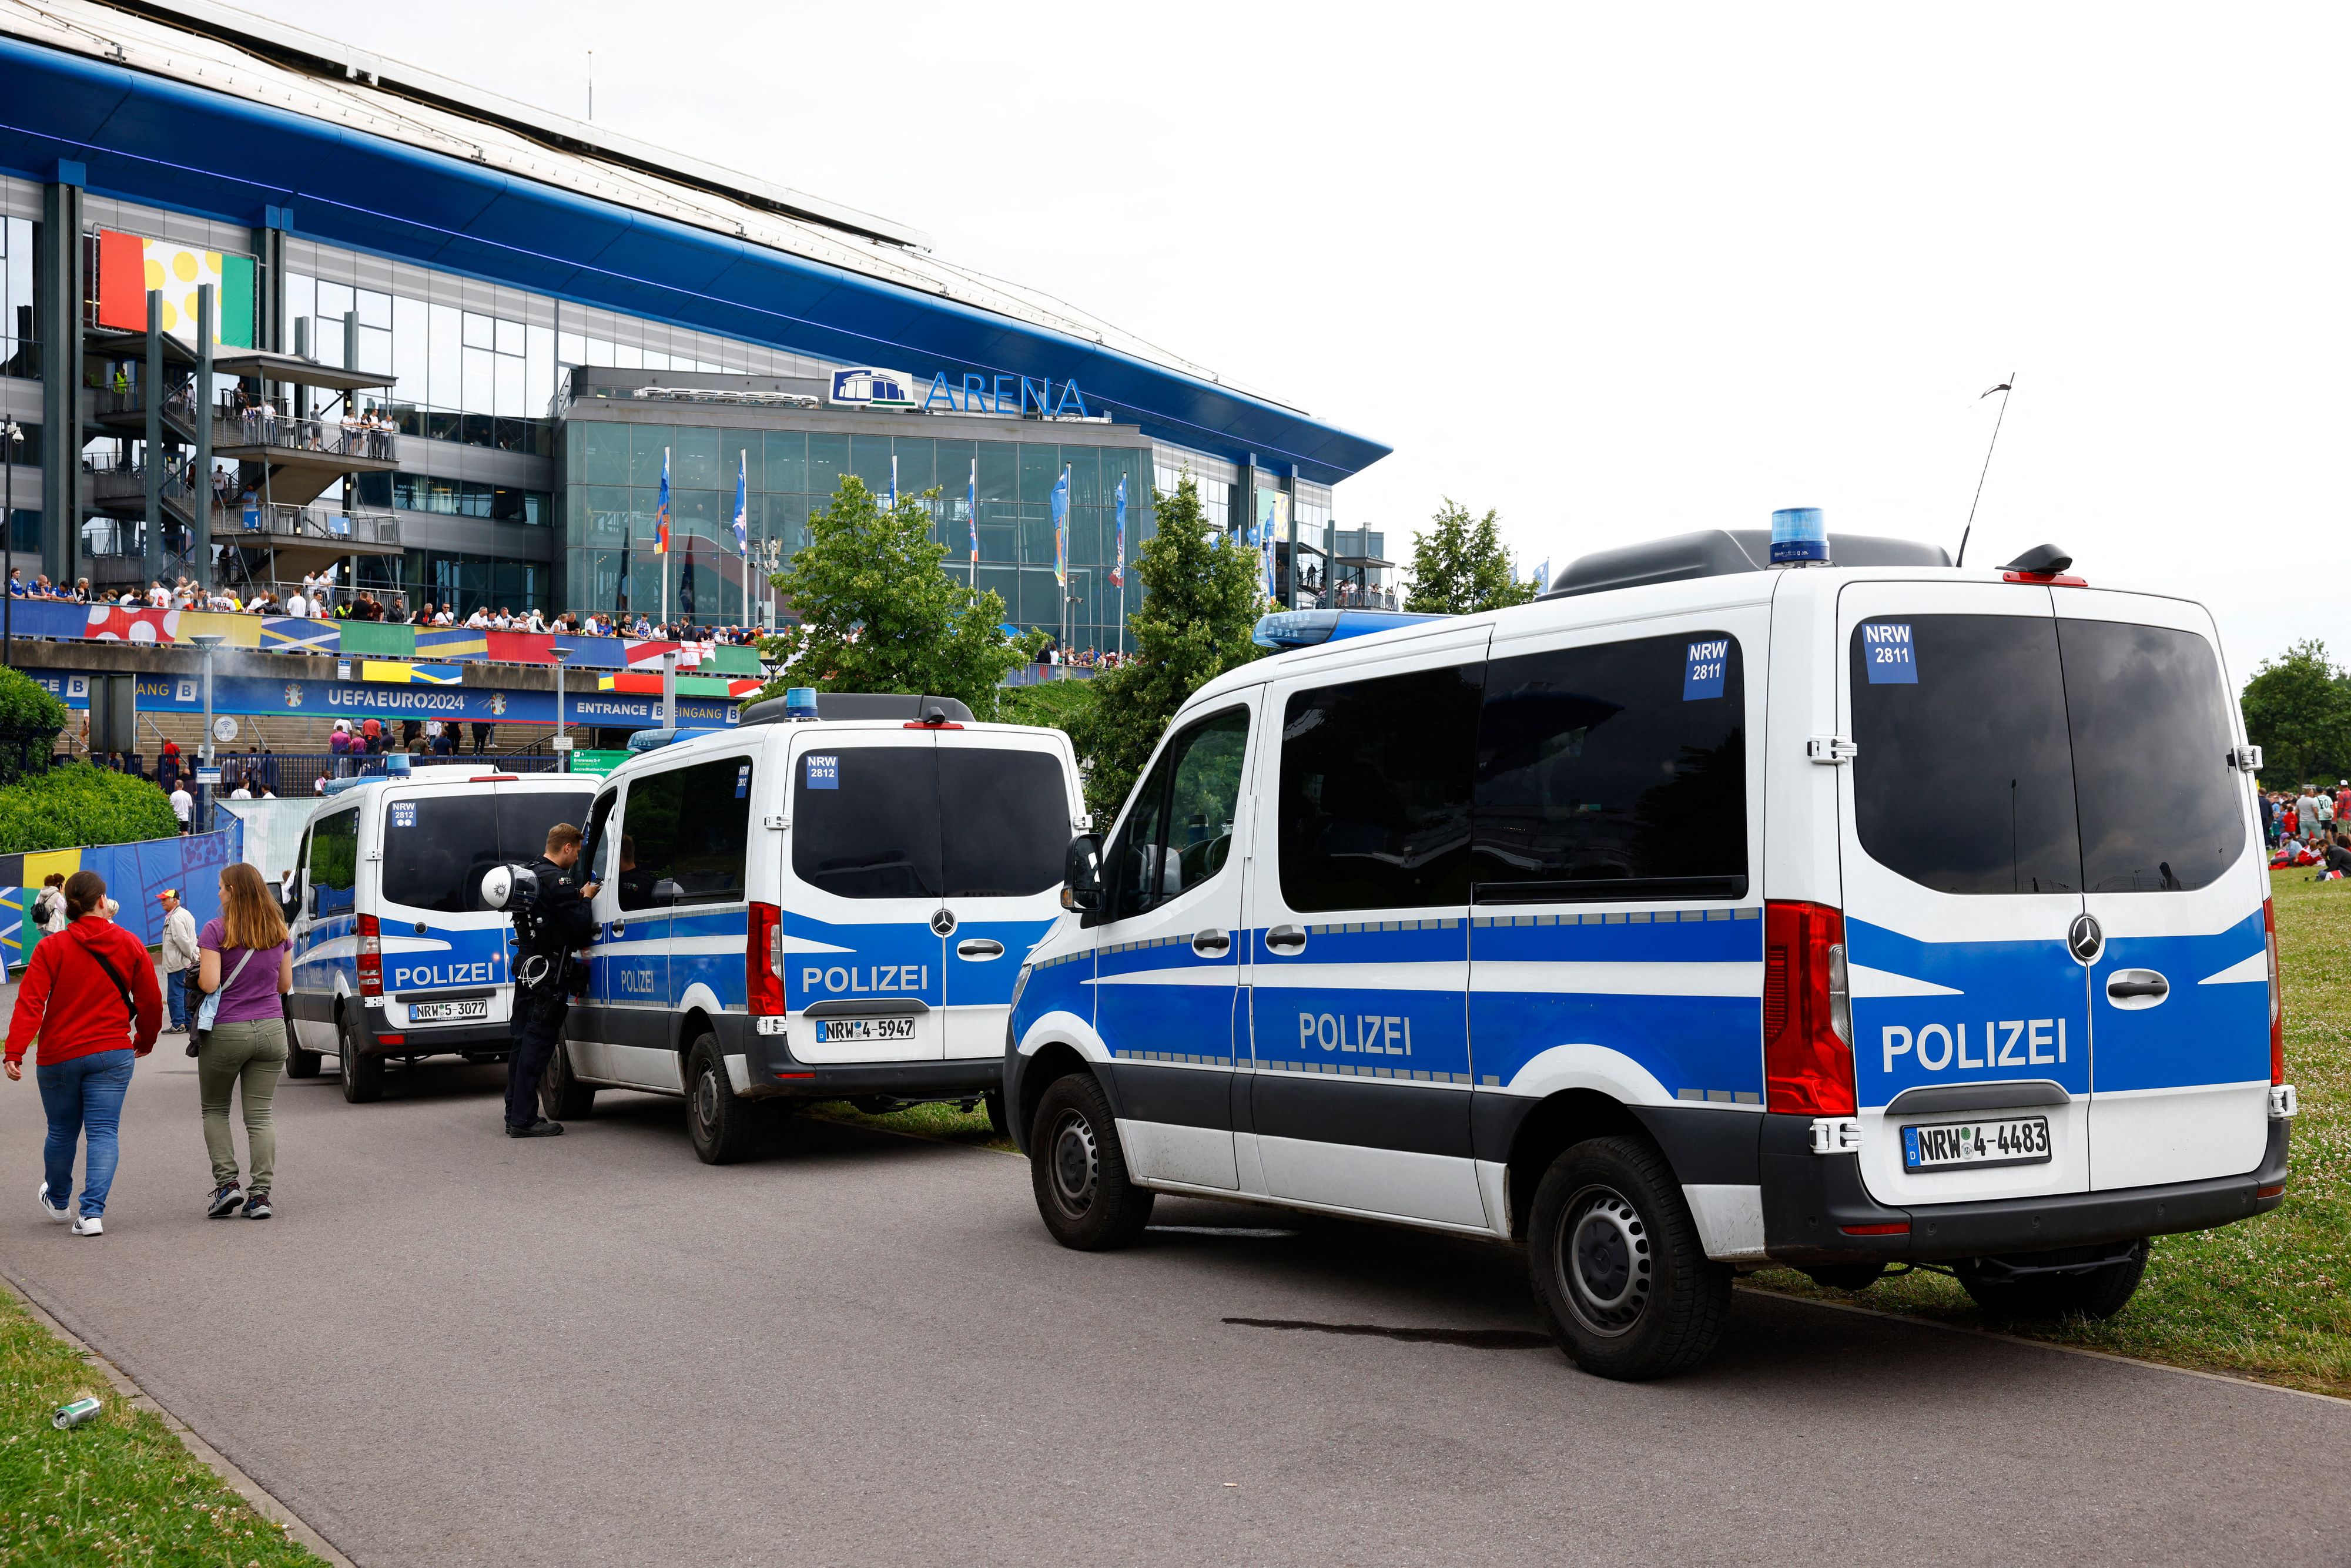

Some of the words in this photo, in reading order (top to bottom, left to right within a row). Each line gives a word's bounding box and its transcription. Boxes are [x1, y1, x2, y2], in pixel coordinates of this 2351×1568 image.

[922, 371, 1088, 417] ARENA
[254, 515, 259, 527] 1
[343, 522, 348, 533] 1
[1866, 626, 1910, 642] NRW
[1690, 641, 1727, 661] NRW
[1875, 648, 1909, 663] 2811
[1693, 663, 1720, 680] 2811
[73, 680, 83, 692] B
[136, 682, 169, 696] ANG
[182, 685, 192, 697] B
[577, 702, 647, 716] ENTRANCE
[656, 706, 664, 716] B
[675, 707, 722, 719] EINGANG
[731, 710, 738, 719] B
[808, 757, 836, 766] NRW
[738, 766, 749, 775] NRW
[811, 769, 835, 778] 2812
[738, 778, 747, 786] 2812
[396, 962, 493, 987] POLIZEI
[621, 970, 654, 993] POLIZEI
[803, 965, 927, 993] POLIZEI
[417, 1004, 438, 1017] NRW
[445, 1001, 485, 1016] 5-3077
[826, 1021, 853, 1039] NRW
[862, 1020, 913, 1037] 4-5947
[1300, 1013, 1411, 1056] POLIZEI
[1882, 1018, 2067, 1073] POLIZEI
[1910, 1151, 1916, 1160] D
[1918, 1128, 1961, 1161] NRW
[1974, 1123, 2047, 1156] 4-4483
